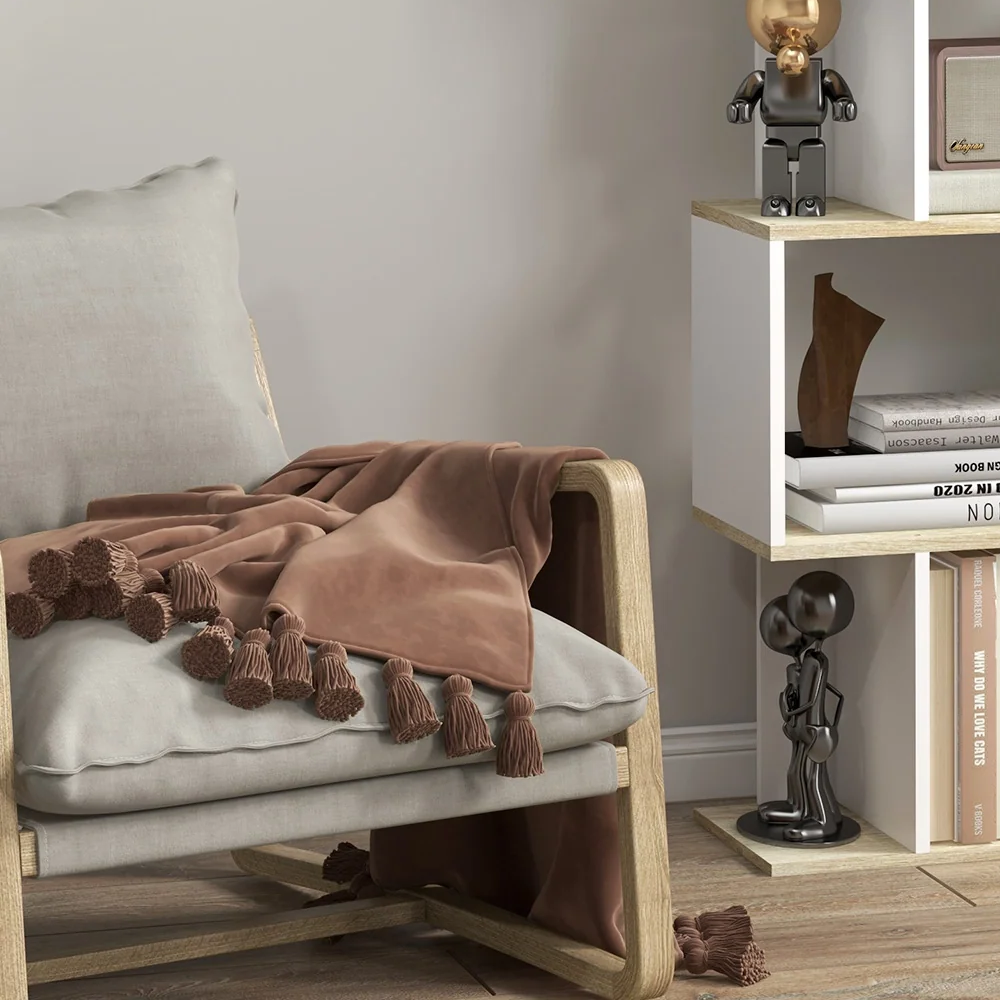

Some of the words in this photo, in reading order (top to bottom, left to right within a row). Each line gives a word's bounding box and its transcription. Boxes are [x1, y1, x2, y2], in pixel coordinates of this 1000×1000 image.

[892, 418, 942, 428] Handbook
[948, 414, 986, 426] Design
[887, 437, 947, 449] Isaacson
[955, 434, 1000, 446] Walter
[955, 462, 985, 473] BOOK
[933, 483, 973, 497] 2020
[977, 483, 991, 495] IN
[974, 650, 986, 675] WHY
[974, 677, 985, 691] DO
[974, 693, 985, 710] WE
[974, 713, 985, 737] LOVE
[974, 740, 986, 766] CATS
